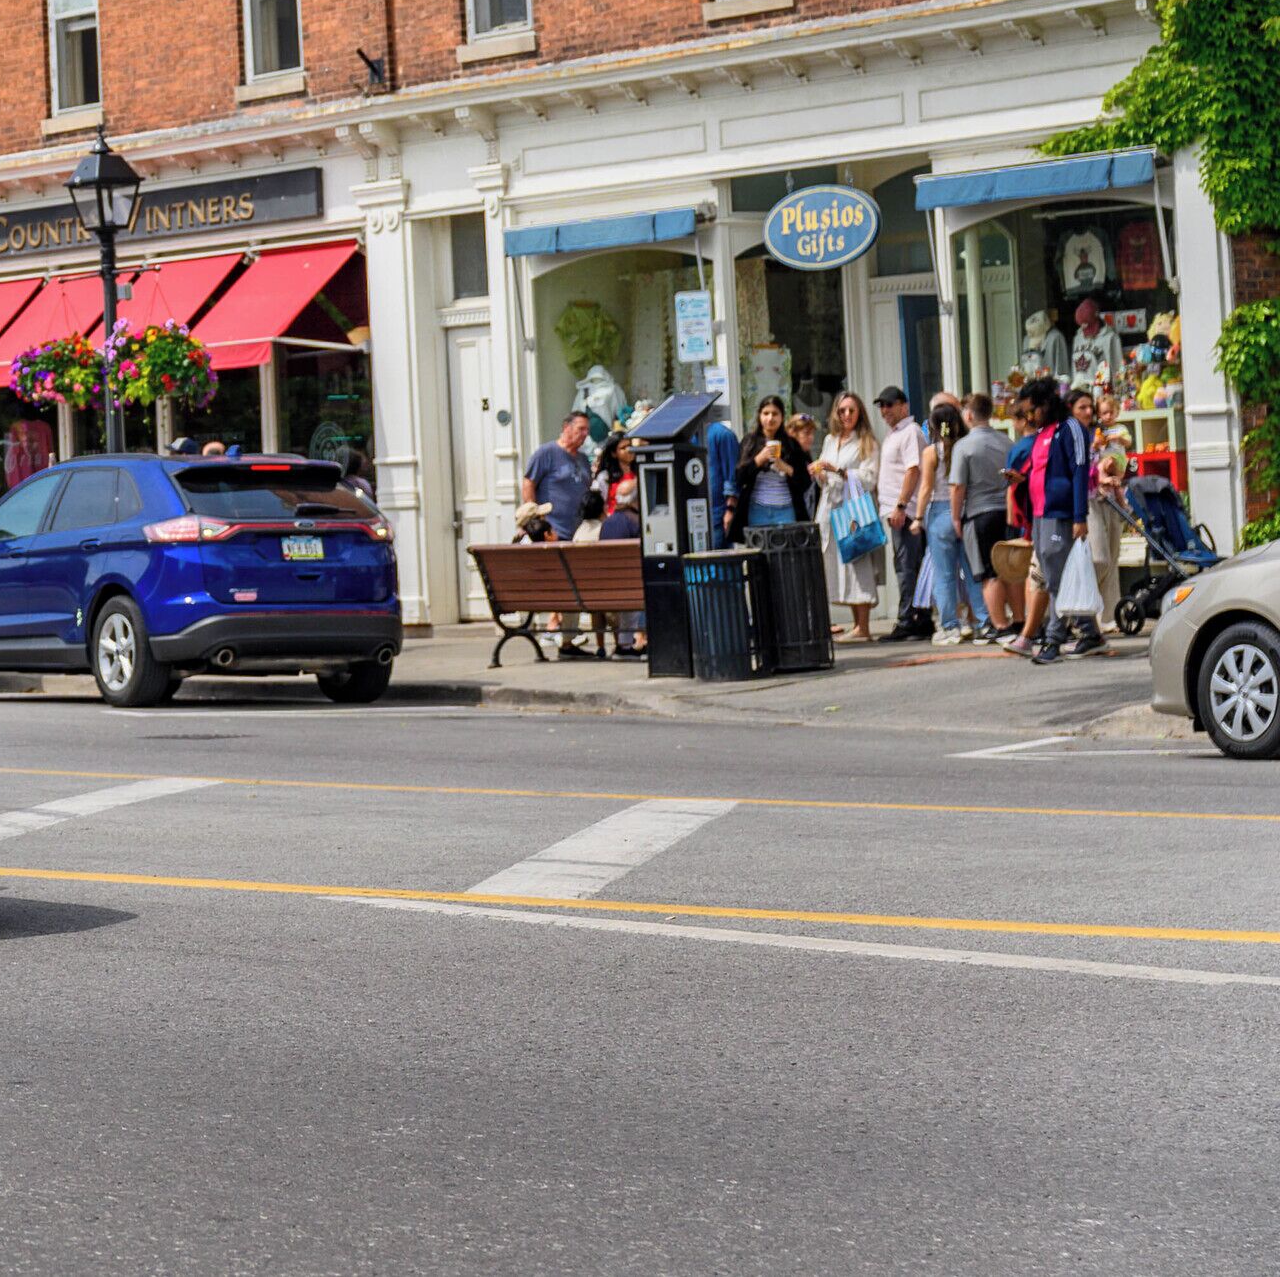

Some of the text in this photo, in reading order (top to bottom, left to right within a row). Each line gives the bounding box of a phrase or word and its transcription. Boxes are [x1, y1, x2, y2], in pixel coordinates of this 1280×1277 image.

[781, 200, 864, 236] Plusios
[797, 233, 845, 262] Gifts
[691, 464, 701, 478] P
